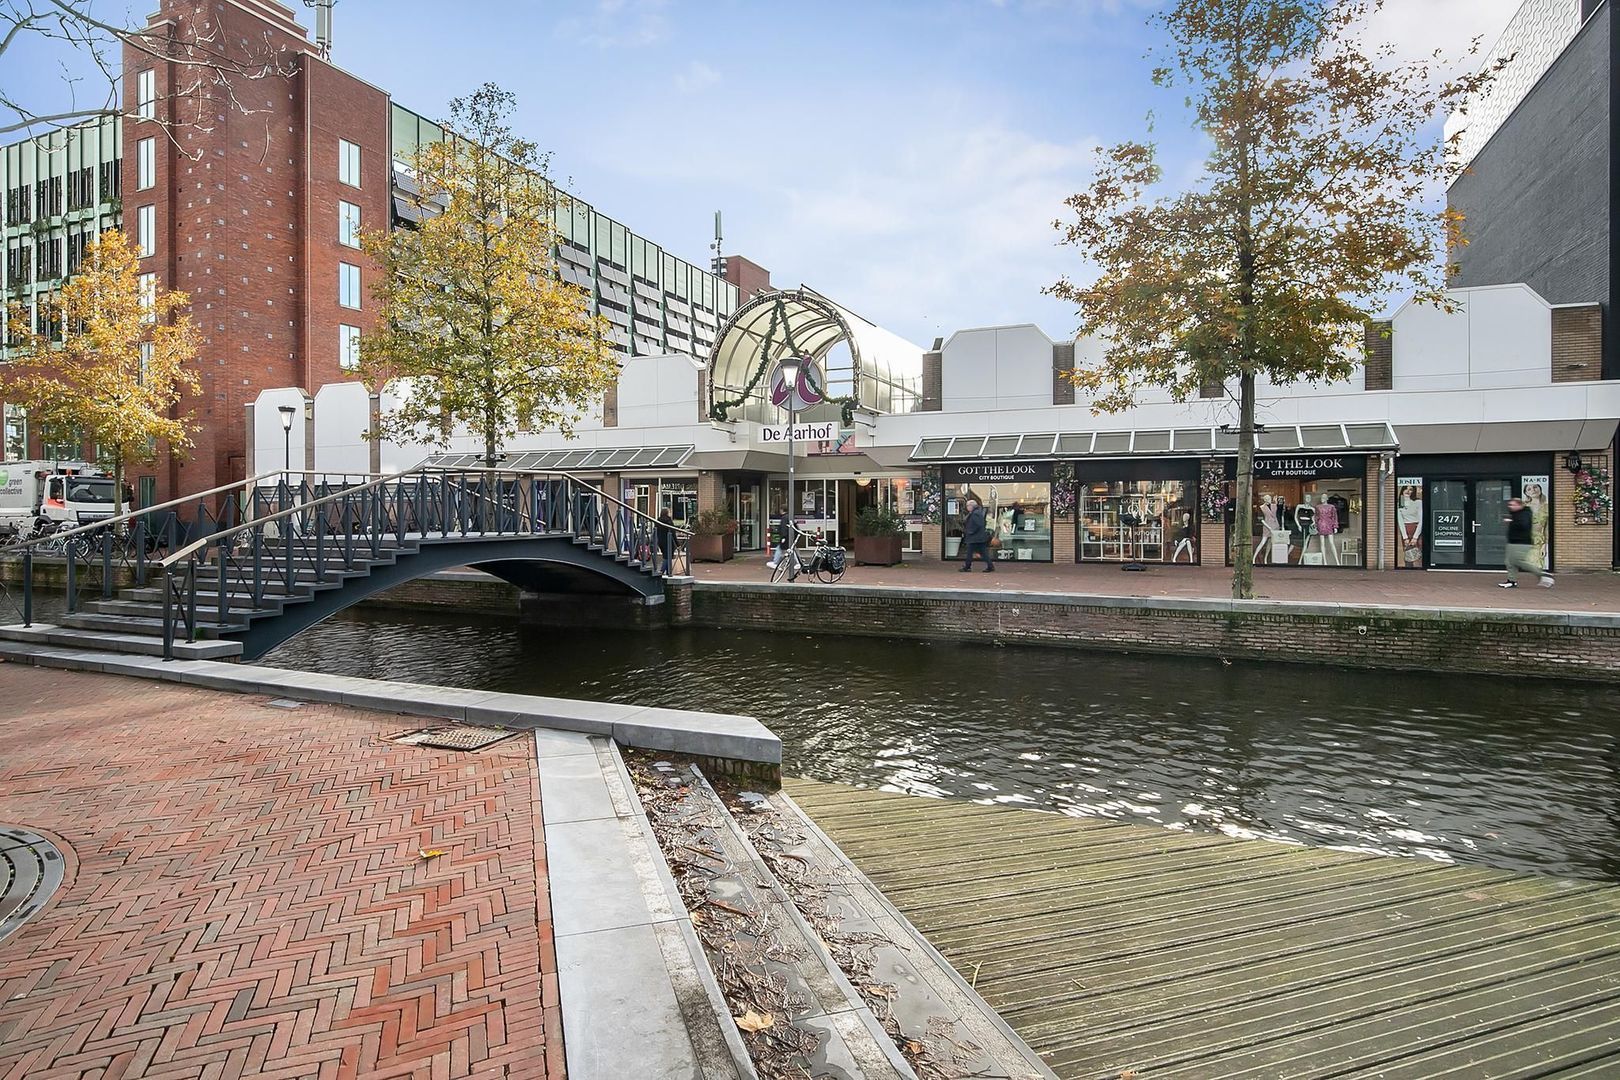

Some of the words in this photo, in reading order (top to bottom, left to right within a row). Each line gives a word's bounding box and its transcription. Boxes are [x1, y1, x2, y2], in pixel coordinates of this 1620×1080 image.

[763, 428, 780, 441] De
[783, 423, 832, 441] Aarhof
[1254, 460, 1273, 469] OT
[1275, 459, 1303, 469] THE
[1304, 458, 1343, 469] LOOK
[958, 466, 980, 475] GOT
[982, 465, 1005, 475] THE
[1005, 465, 1036, 474] LOOK
[9, 479, 22, 488] green
[1438, 515, 1460, 523] 24/7
